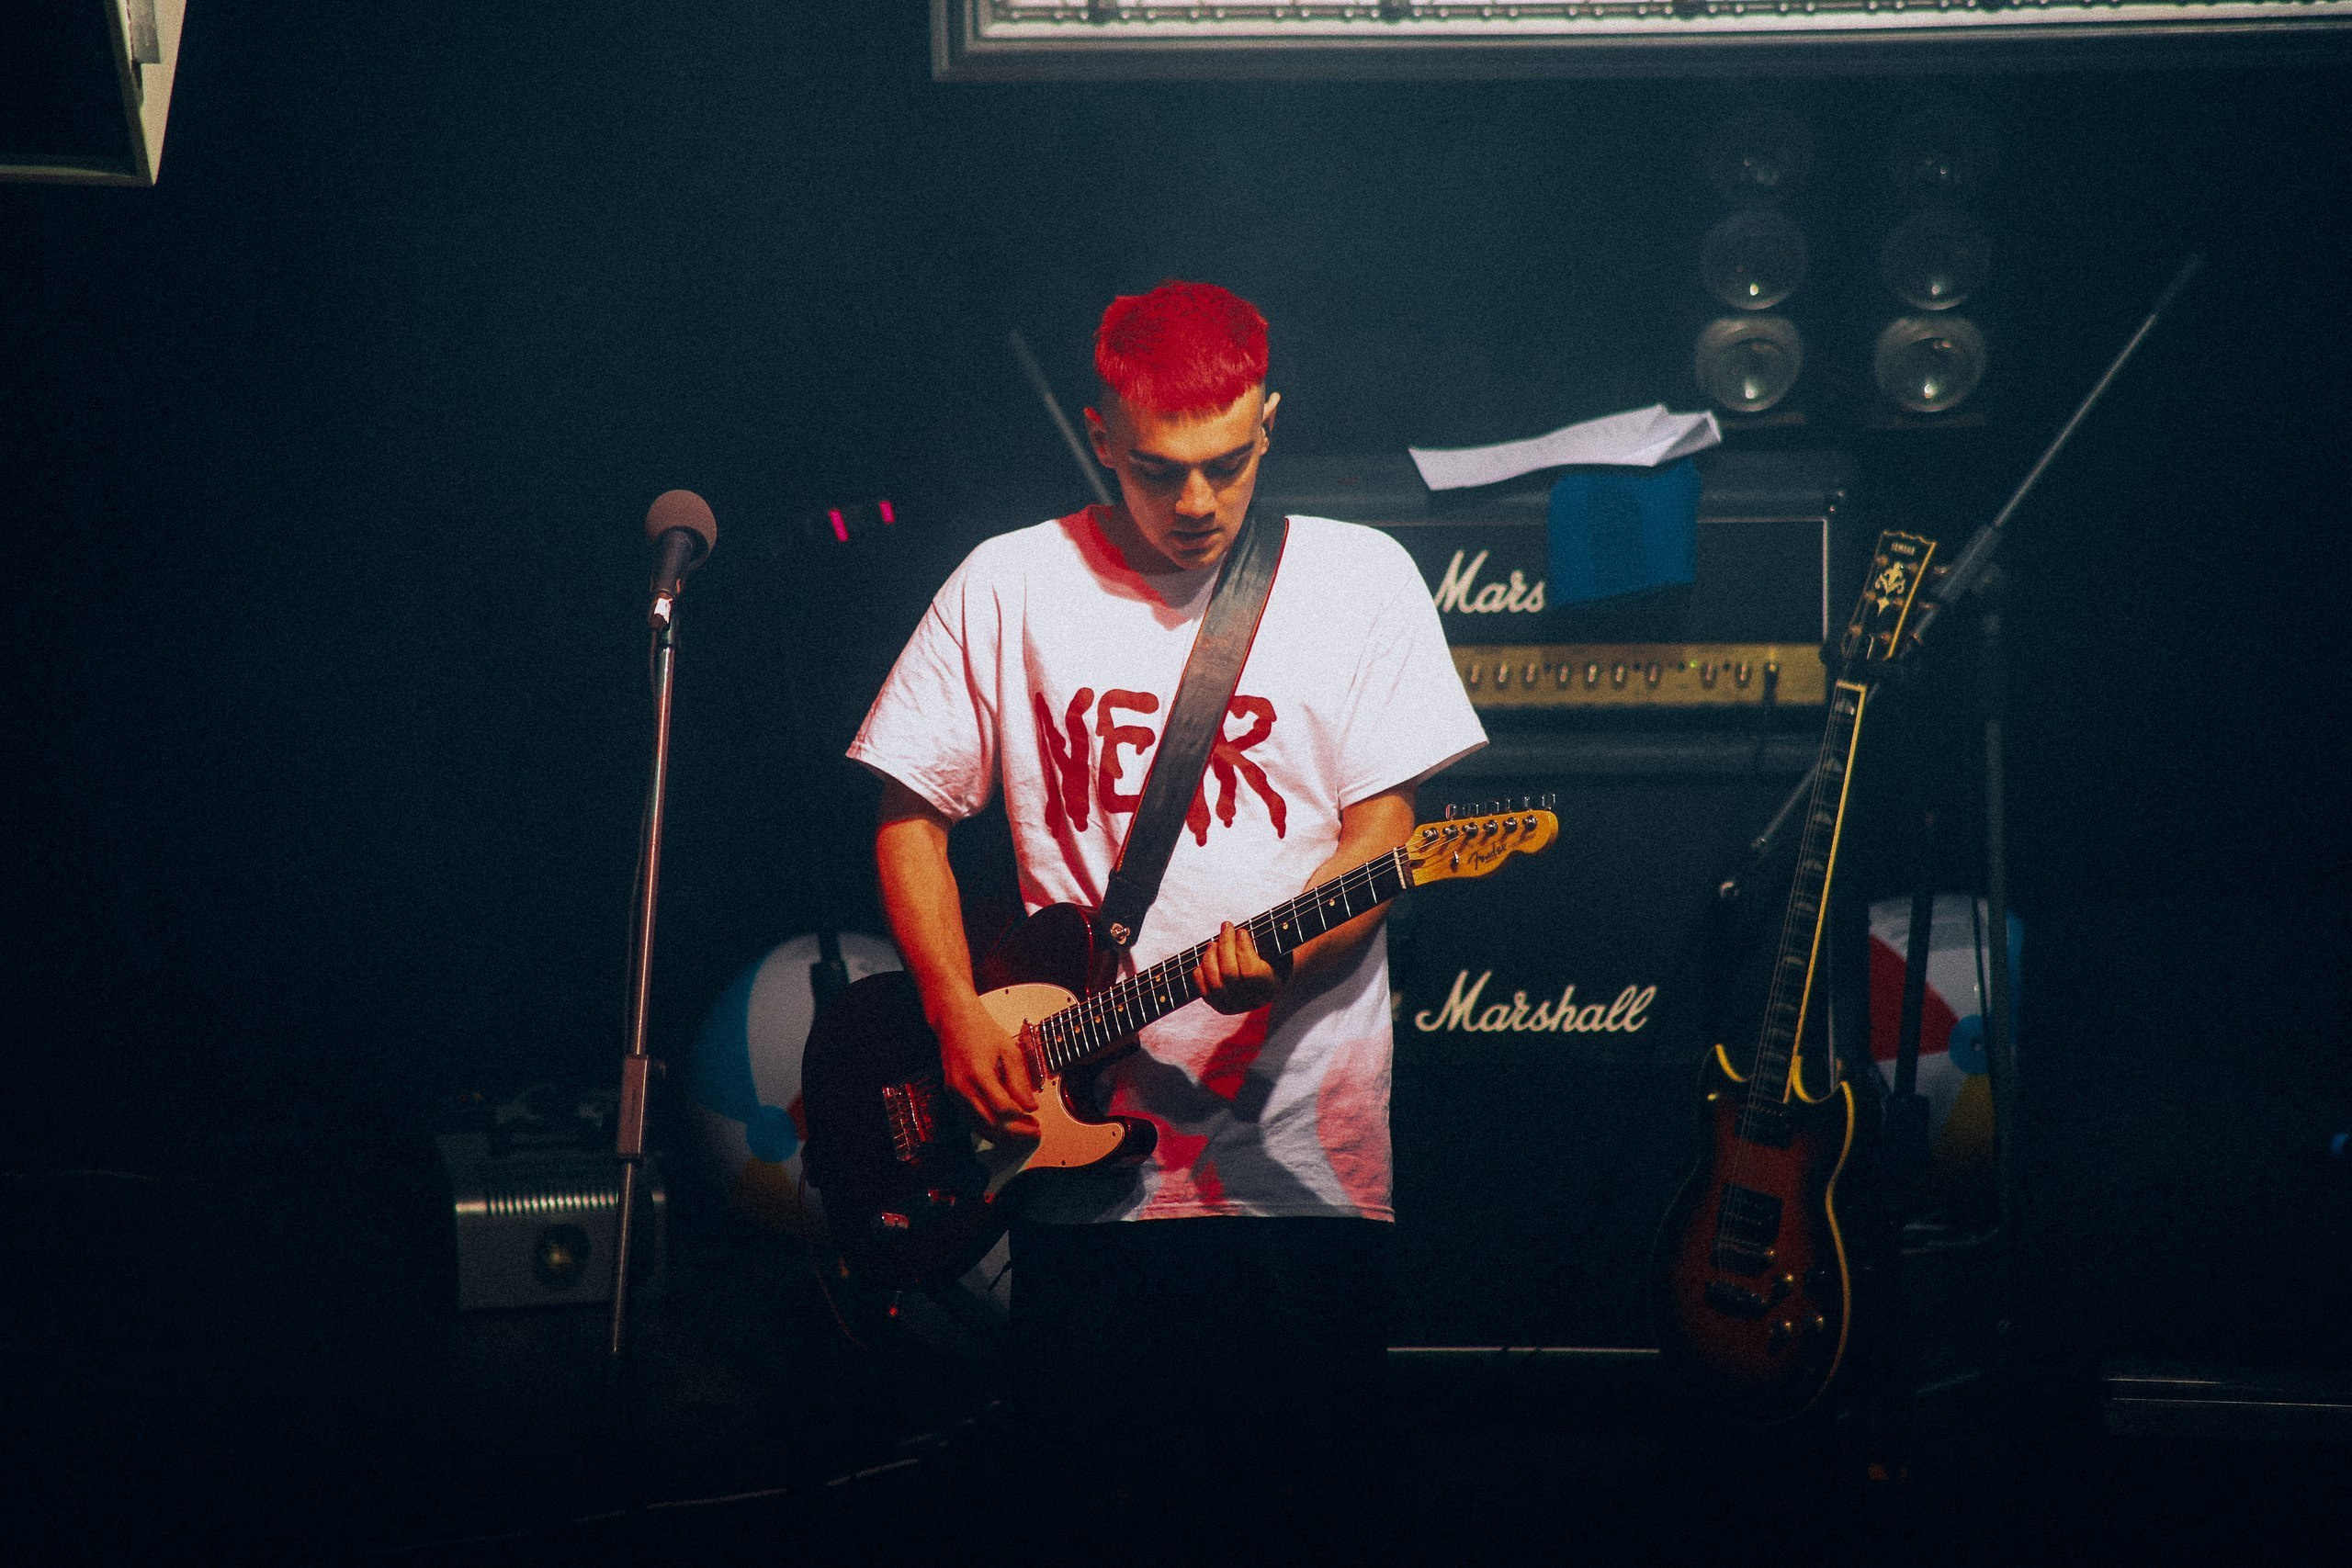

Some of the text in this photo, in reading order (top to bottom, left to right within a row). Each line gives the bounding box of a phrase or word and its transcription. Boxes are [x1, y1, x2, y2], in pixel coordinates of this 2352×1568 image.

[1432, 549, 1545, 613] Mars
[1035, 687, 1287, 847] NER
[1467, 840, 1508, 871] Fender
[1415, 969, 1657, 1033] Marshall
